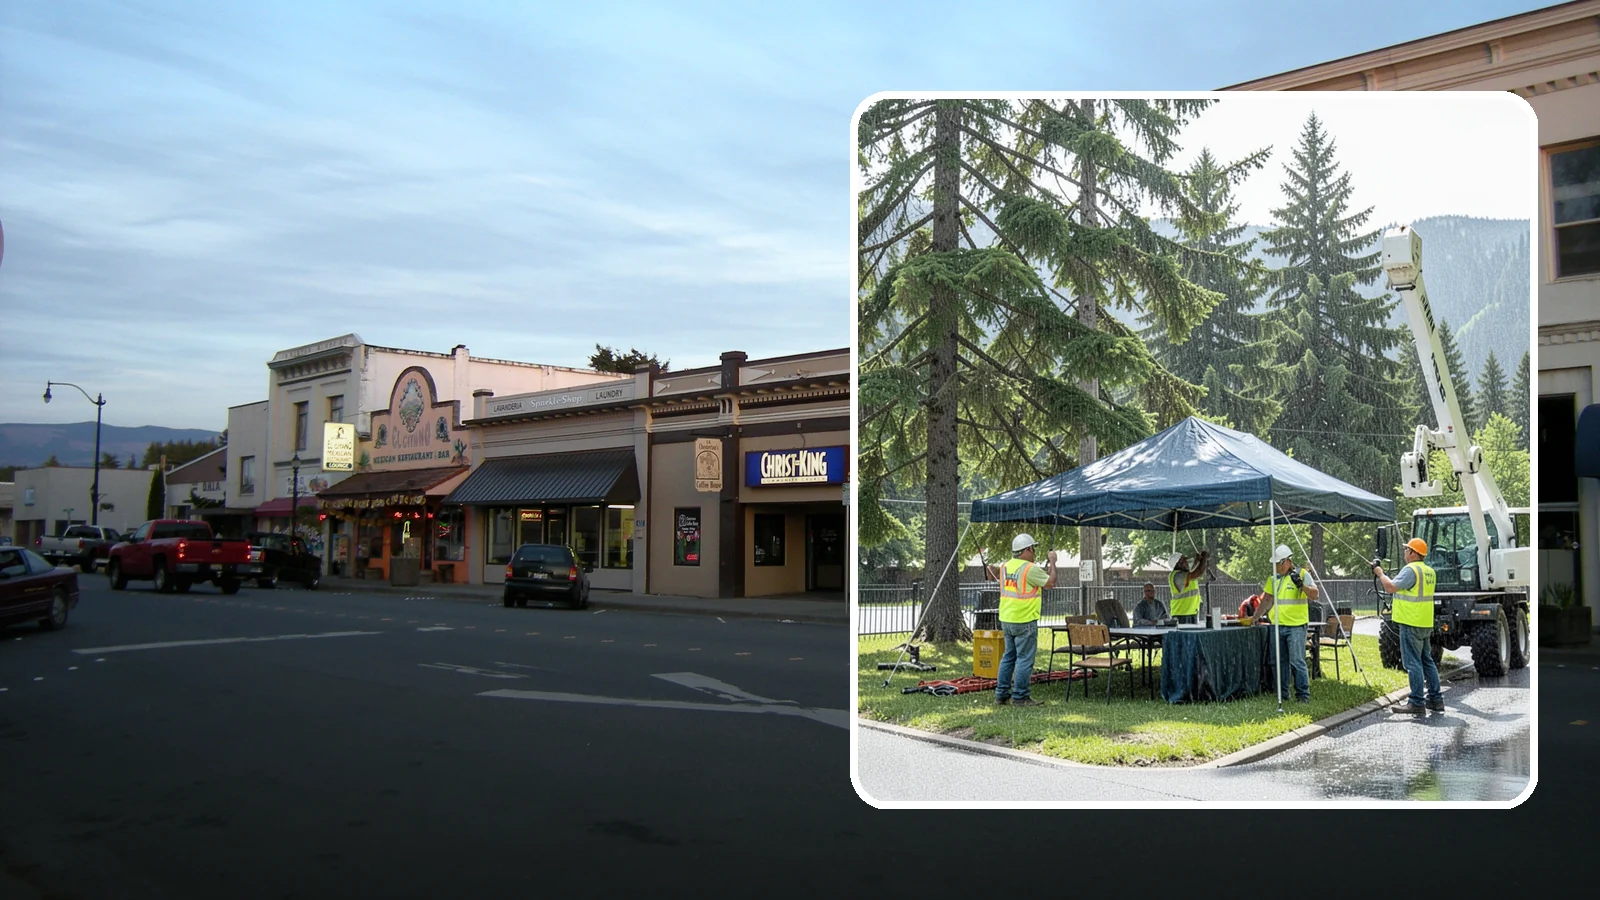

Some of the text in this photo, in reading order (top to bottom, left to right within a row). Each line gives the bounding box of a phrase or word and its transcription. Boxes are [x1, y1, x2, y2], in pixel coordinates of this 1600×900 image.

[493, 402, 522, 412] LAVANDERIA
[595, 389, 623, 400] LAUNDRY
[373, 455, 396, 465] MEXICAN
[397, 451, 433, 463] RESTAURANT
[438, 450, 450, 459] BAR
[761, 450, 827, 478] CHRIST KING
